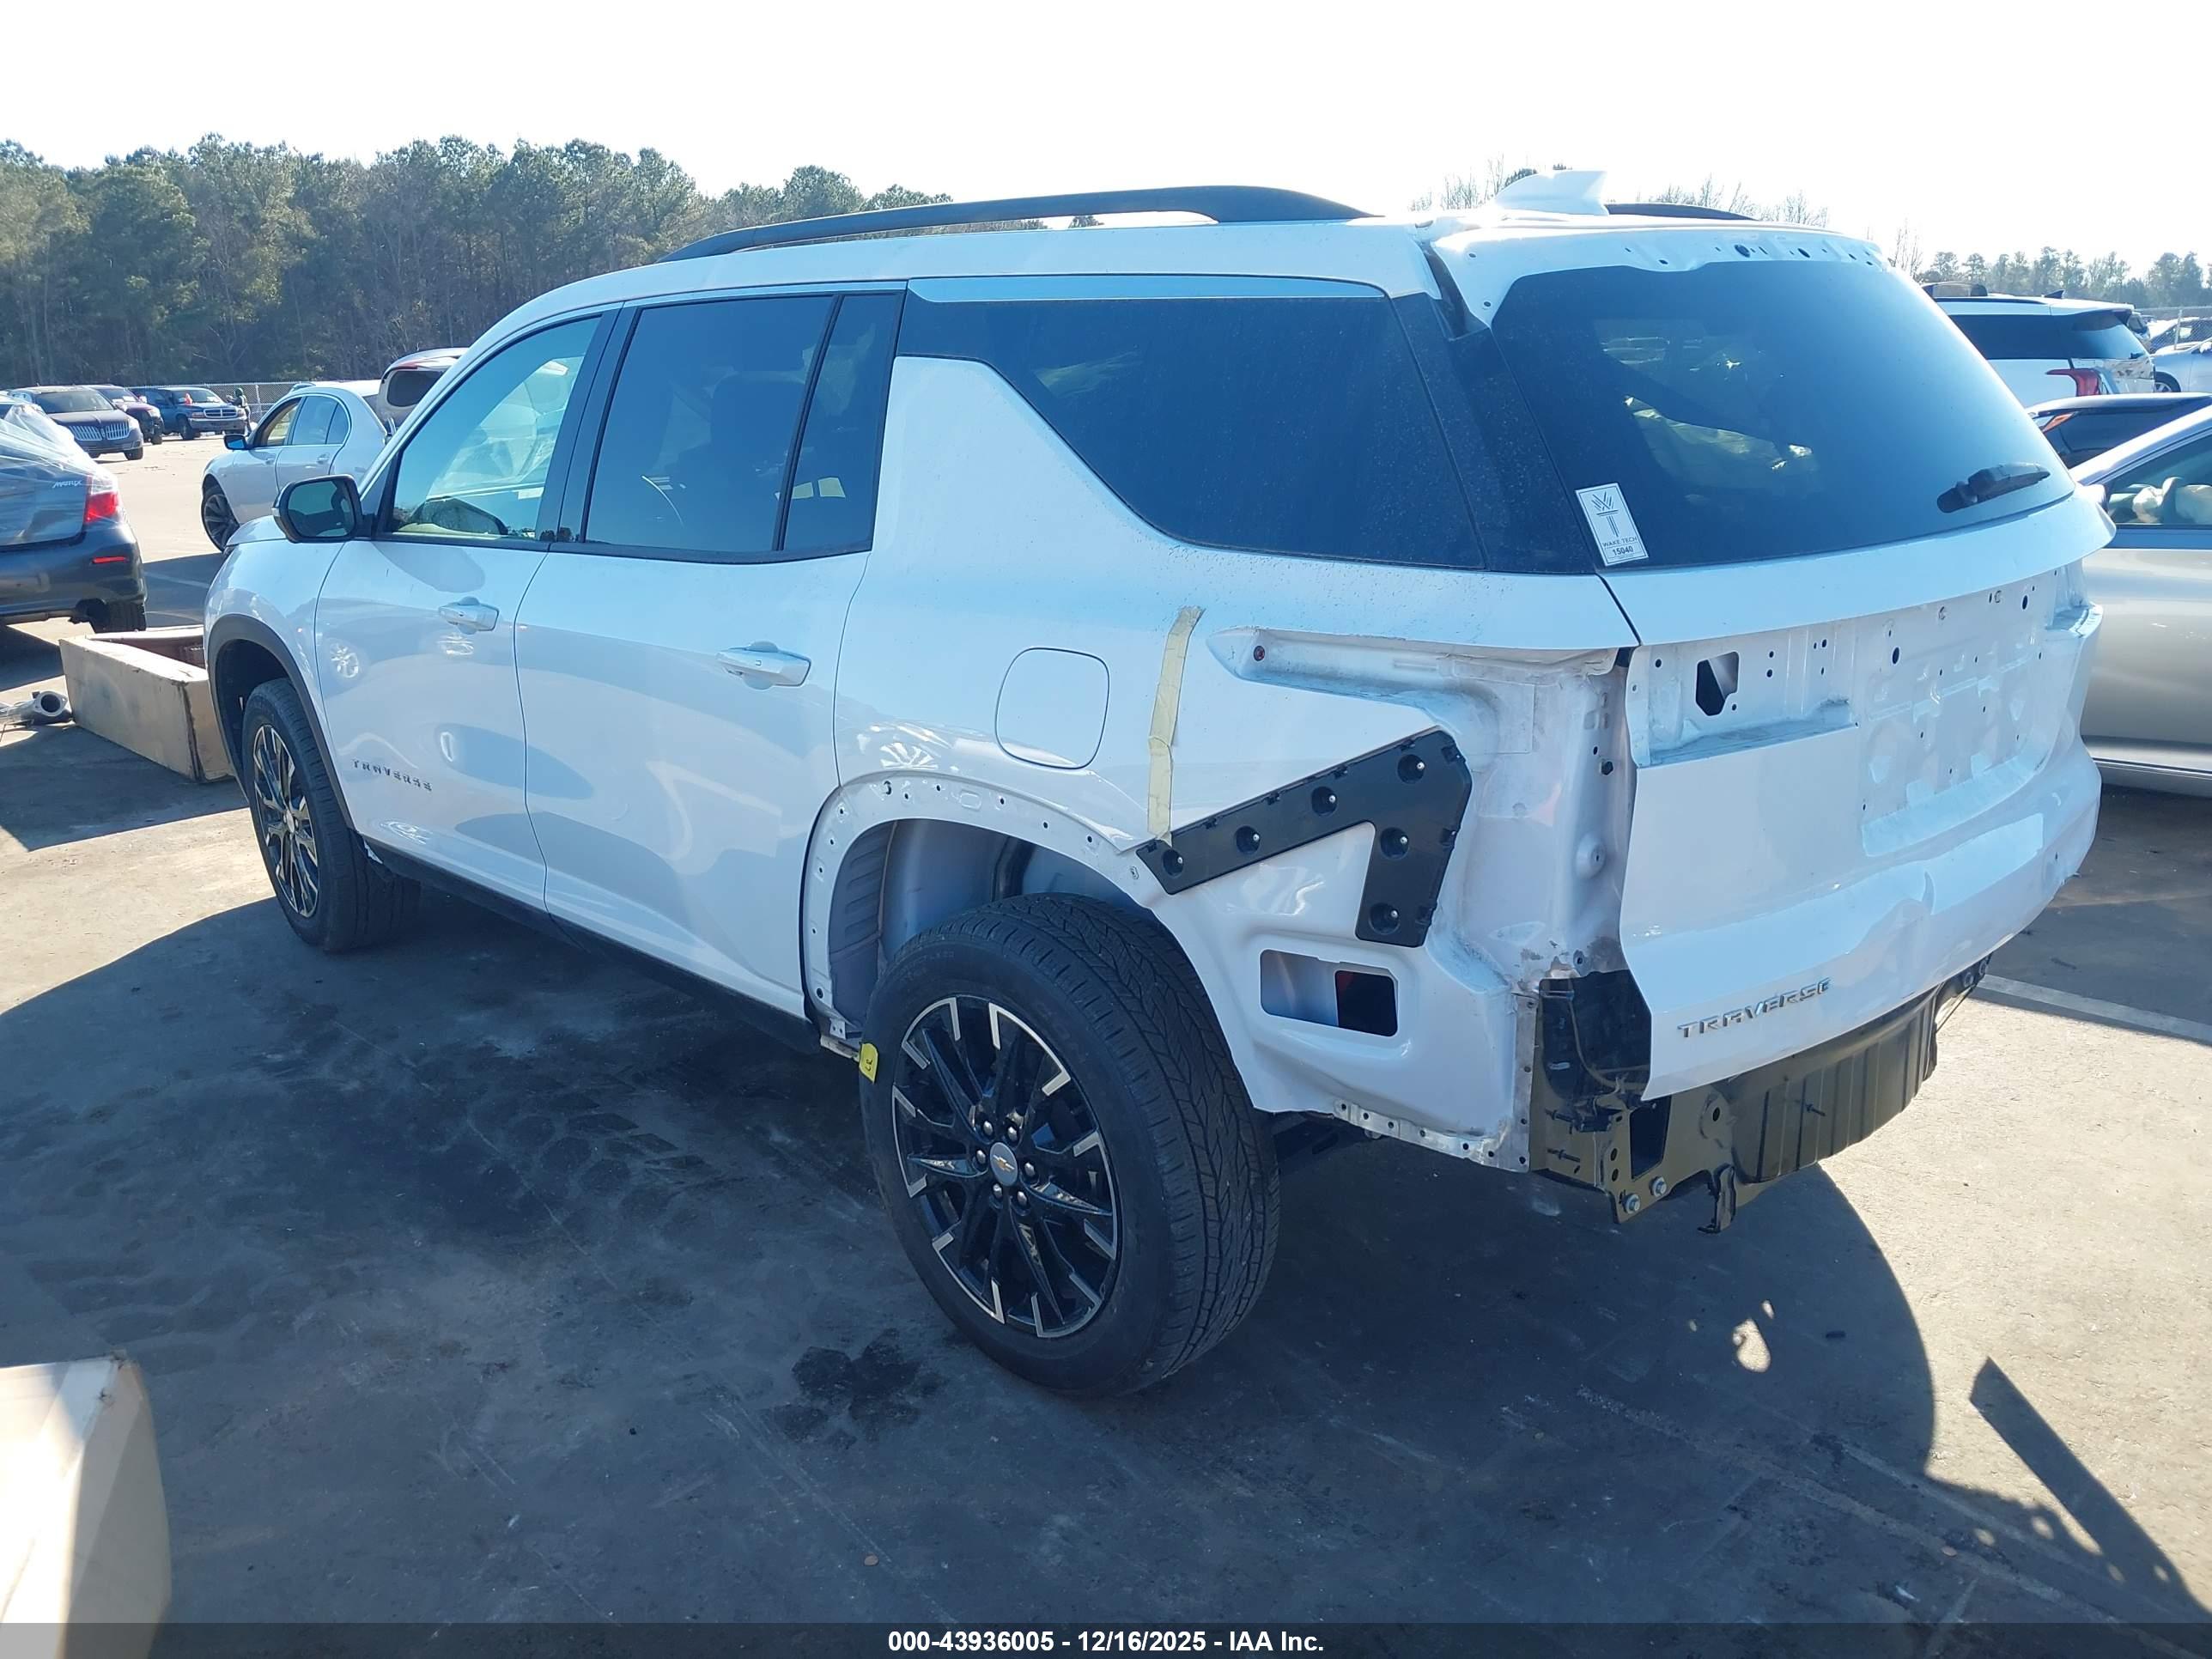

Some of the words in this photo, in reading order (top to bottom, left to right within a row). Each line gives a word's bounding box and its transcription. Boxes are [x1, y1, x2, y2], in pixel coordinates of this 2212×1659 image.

[1602, 539, 1621, 548] WAKE
[1621, 536, 1638, 544] TECH
[1612, 545, 1634, 556] 15040
[351, 758, 432, 791] TRAVERSE
[1676, 976, 1832, 1038] TRAVERSE
